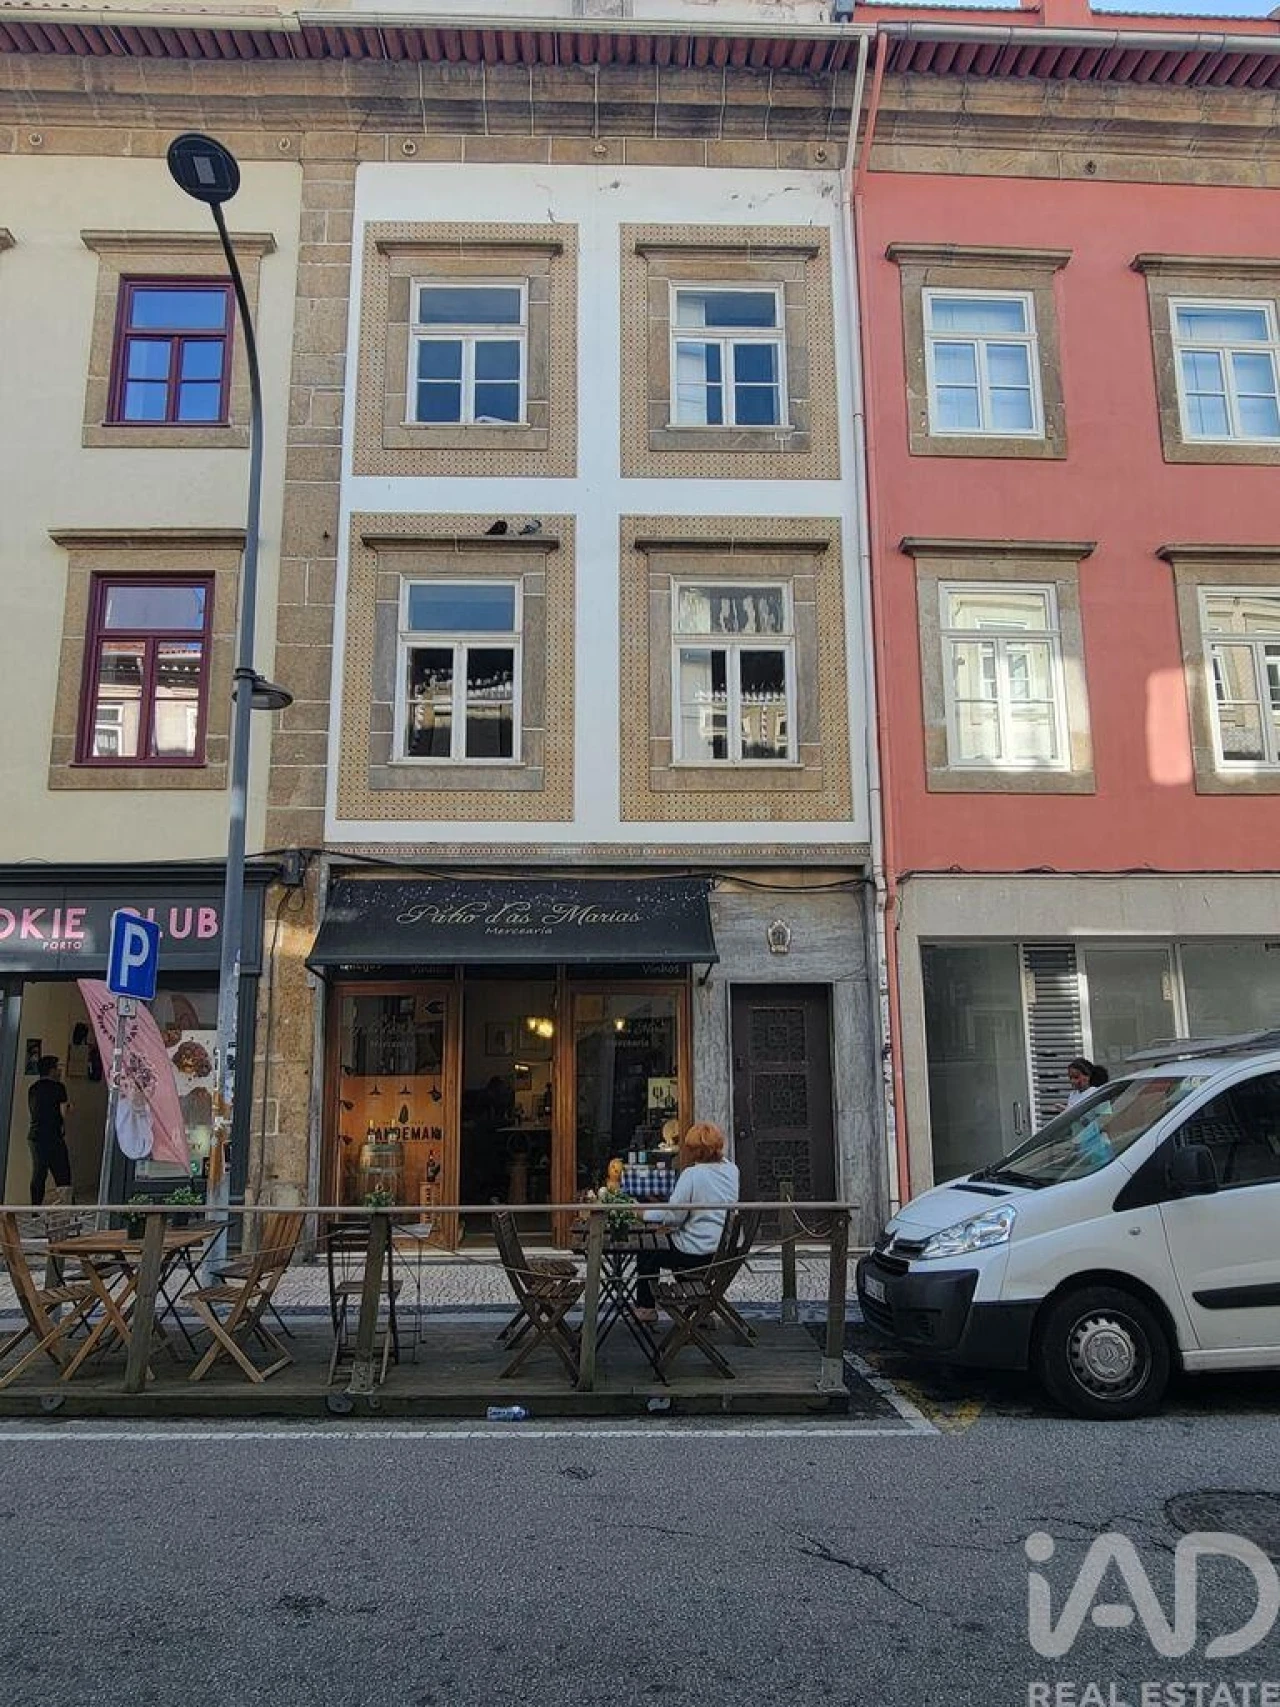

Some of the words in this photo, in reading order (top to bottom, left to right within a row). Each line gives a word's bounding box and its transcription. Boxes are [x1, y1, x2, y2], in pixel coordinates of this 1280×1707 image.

[542, 903, 642, 926] Marias
[485, 926, 553, 935] Mercearia
[43, 941, 83, 950] PORTO
[119, 922, 150, 988] P
